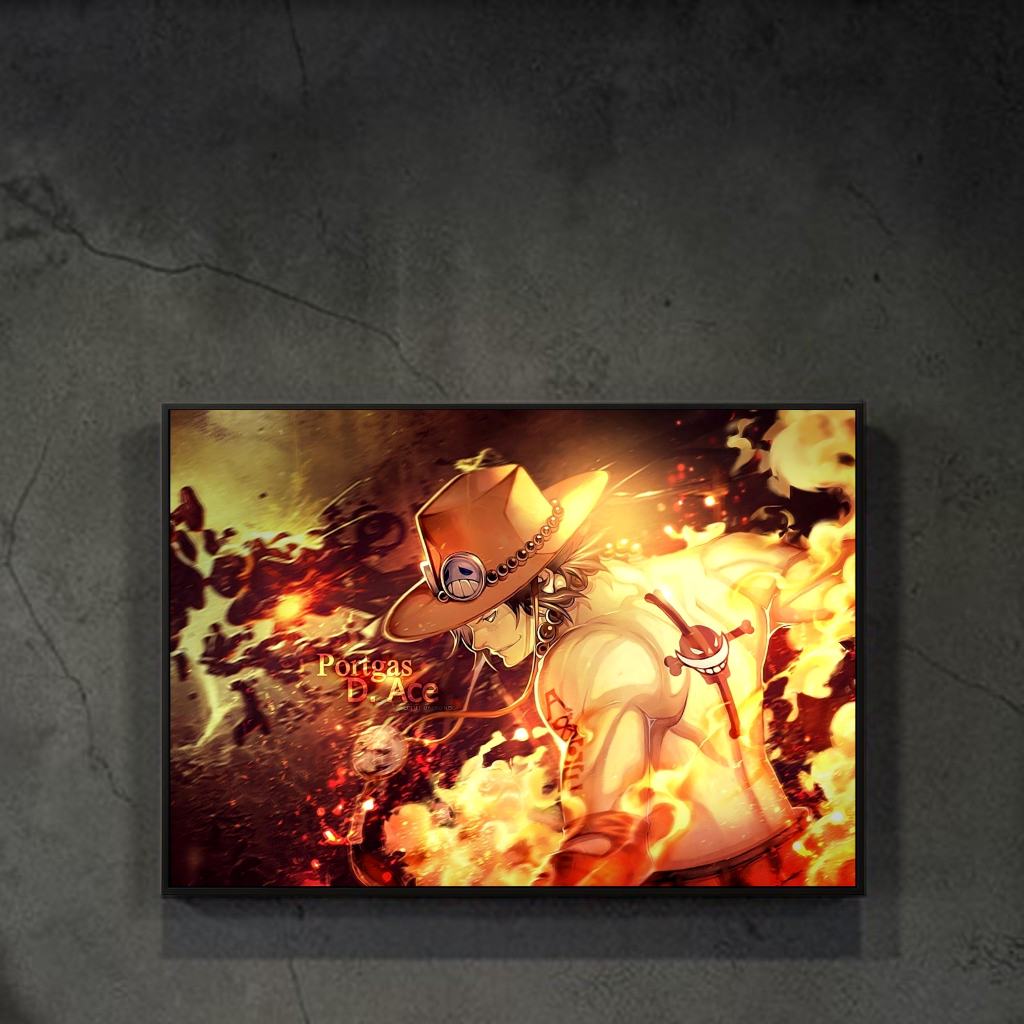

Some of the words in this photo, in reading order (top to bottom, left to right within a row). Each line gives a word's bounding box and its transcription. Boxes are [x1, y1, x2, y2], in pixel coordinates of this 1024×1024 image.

[317, 653, 413, 683] Portgas
[347, 677, 376, 703] D.
[388, 677, 439, 703] Ace
